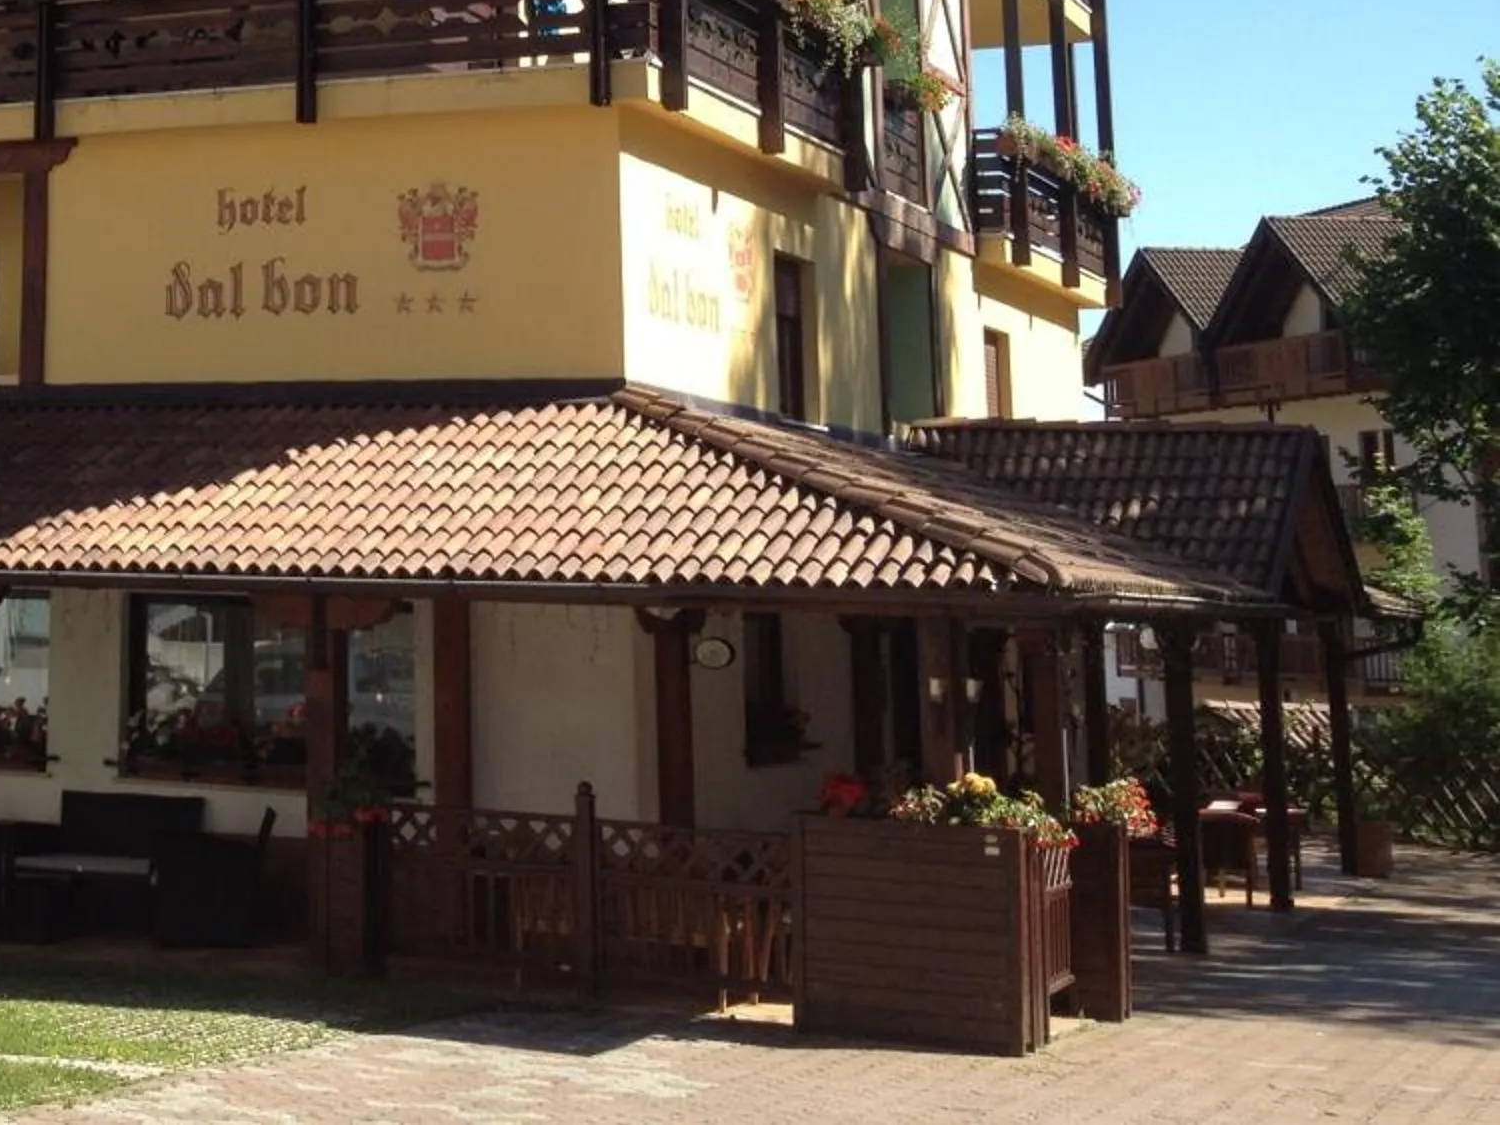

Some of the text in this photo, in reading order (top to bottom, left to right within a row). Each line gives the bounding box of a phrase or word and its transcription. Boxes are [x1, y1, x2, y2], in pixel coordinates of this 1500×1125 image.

[216, 185, 307, 235] hotel
[165, 256, 360, 320] dal bon
